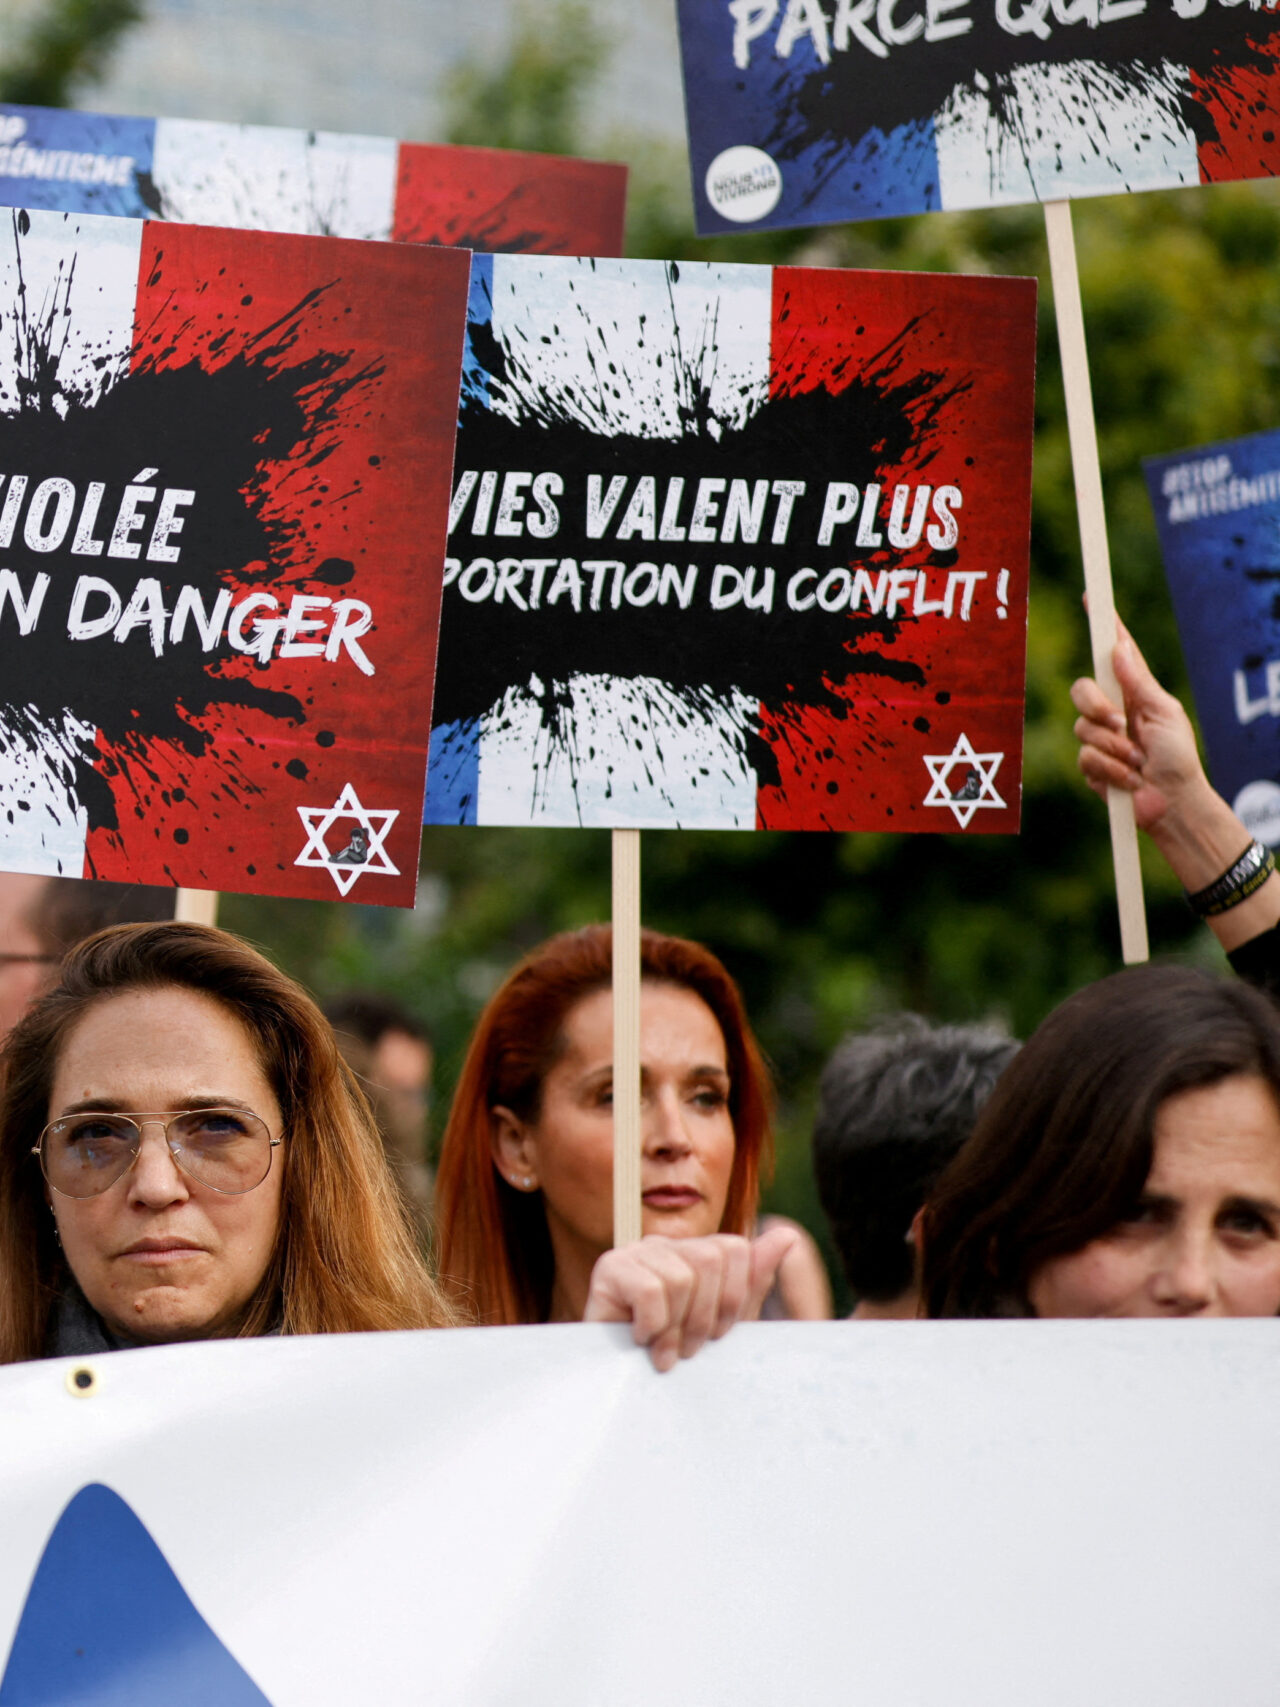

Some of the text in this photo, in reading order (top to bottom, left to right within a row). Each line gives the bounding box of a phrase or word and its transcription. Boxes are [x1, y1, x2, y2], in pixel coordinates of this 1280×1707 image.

[728, 0, 973, 70] PARCE
[586, 474, 806, 545] VALENT
[817, 481, 962, 550] PLUS
[67, 574, 376, 676] DANGER
[709, 564, 774, 614] DU
[786, 567, 987, 621] CONFLIT
